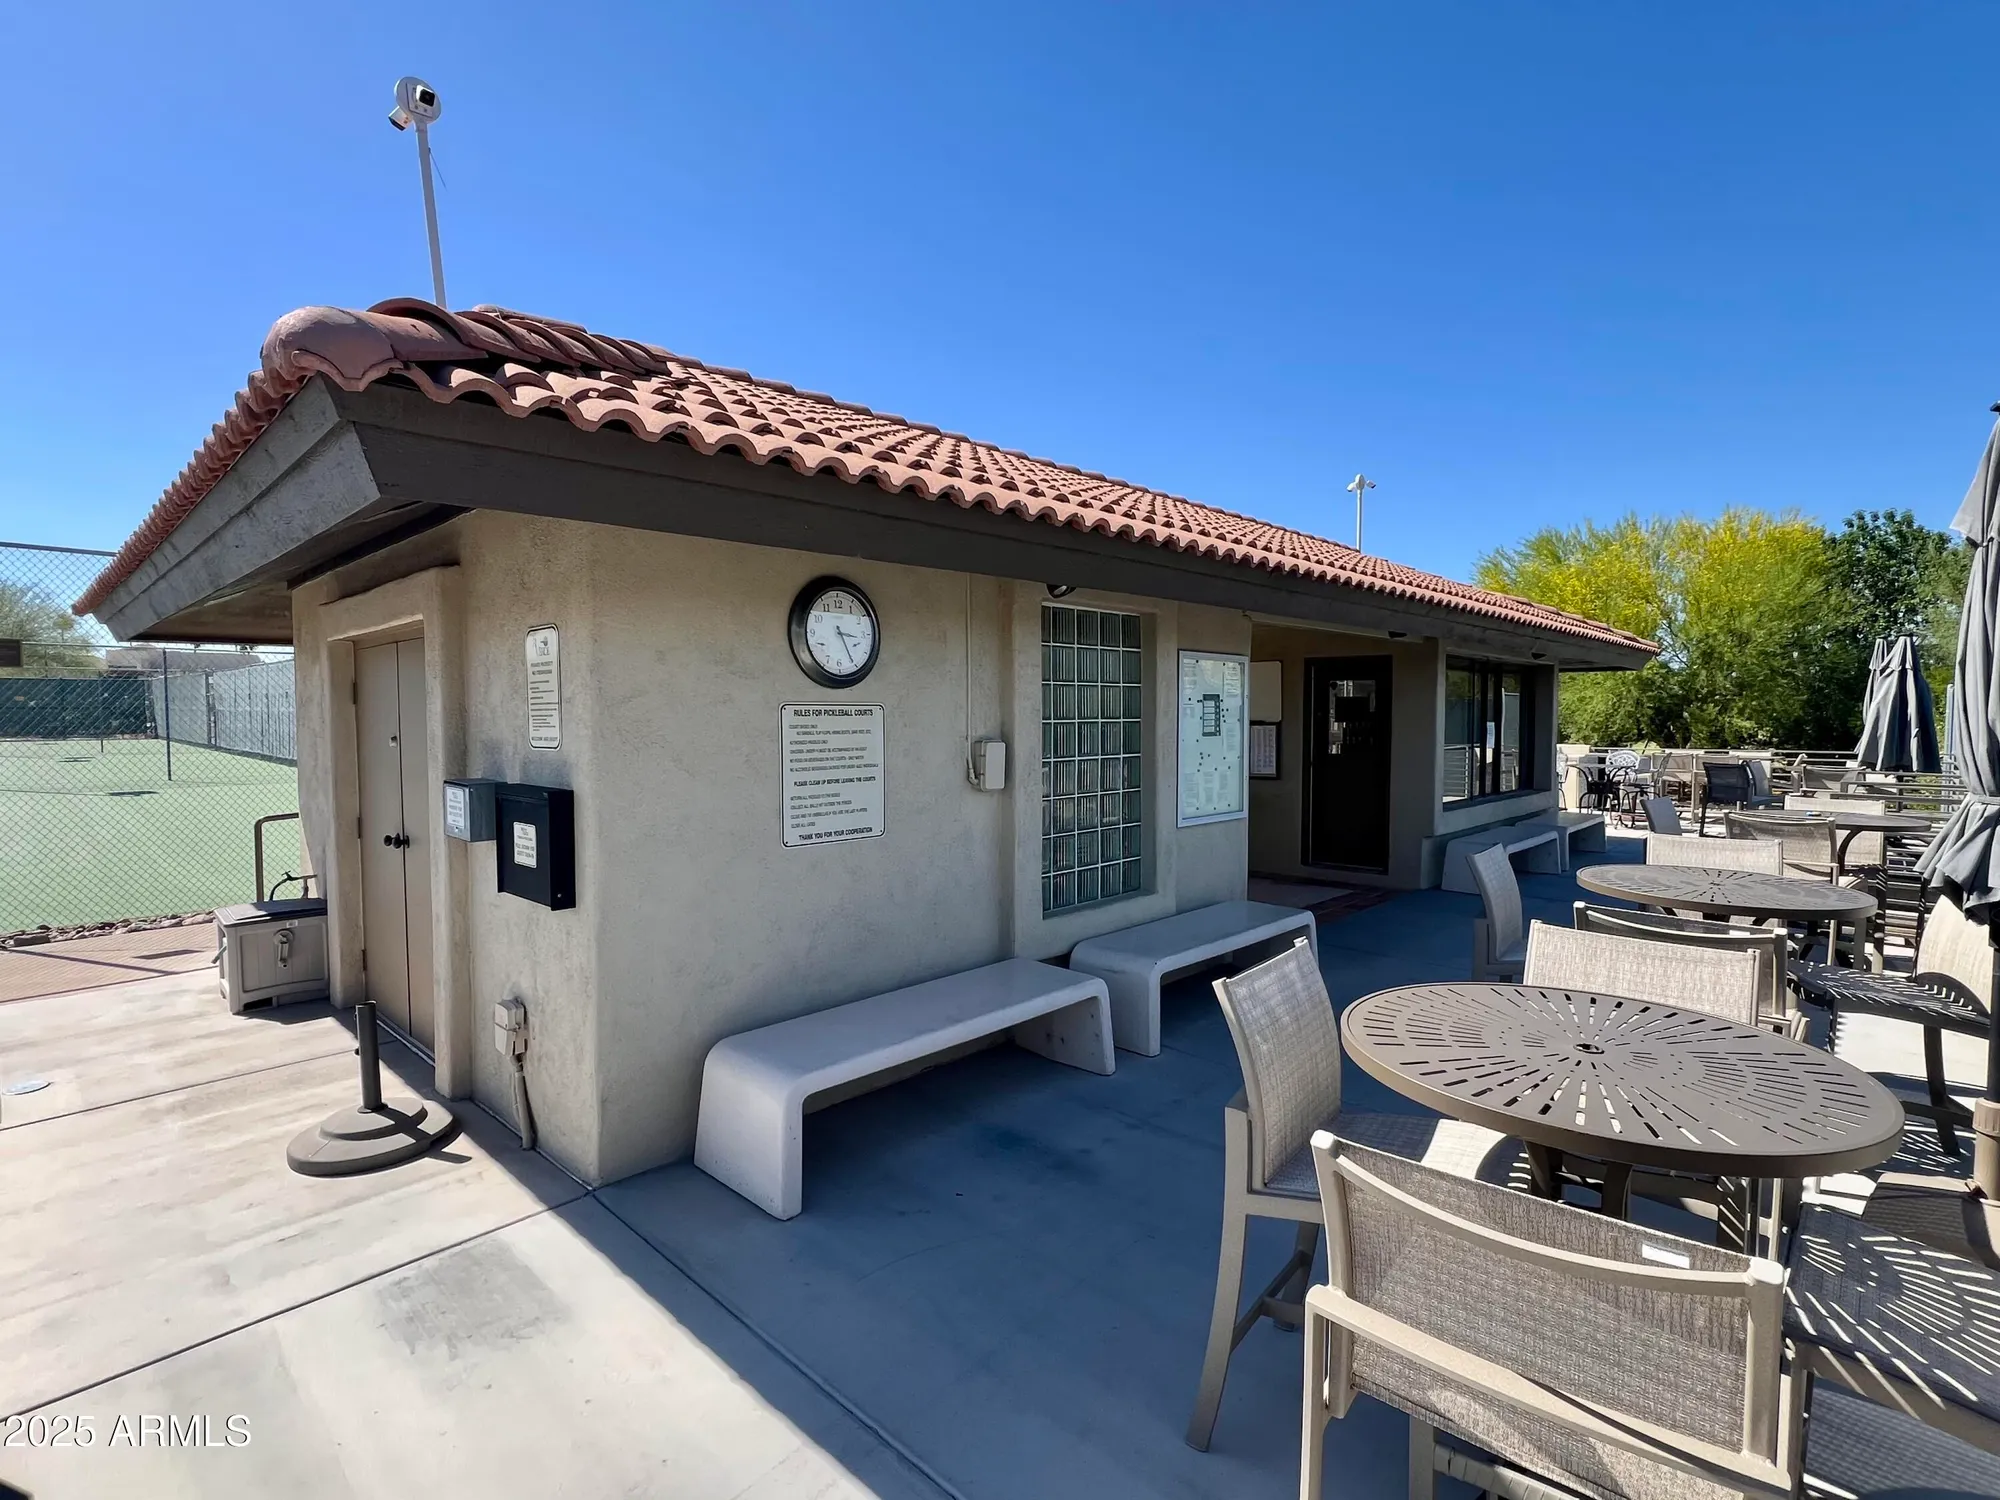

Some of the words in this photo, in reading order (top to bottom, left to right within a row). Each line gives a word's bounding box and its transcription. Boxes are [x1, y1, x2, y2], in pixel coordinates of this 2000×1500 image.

[823, 604, 830, 612] 11
[834, 600, 843, 609] 12
[849, 606, 853, 614] 1
[814, 615, 823, 623] 10
[810, 629, 815, 638] 9
[861, 631, 866, 639] 3
[825, 655, 830, 664] 7
[836, 659, 842, 667] 6
[794, 709, 811, 717] RULES
[812, 709, 823, 717] FOR
[823, 709, 853, 717] PICKLEBALL
[855, 709, 873, 717] COURTS
[845, 827, 873, 836] COOPERATION
